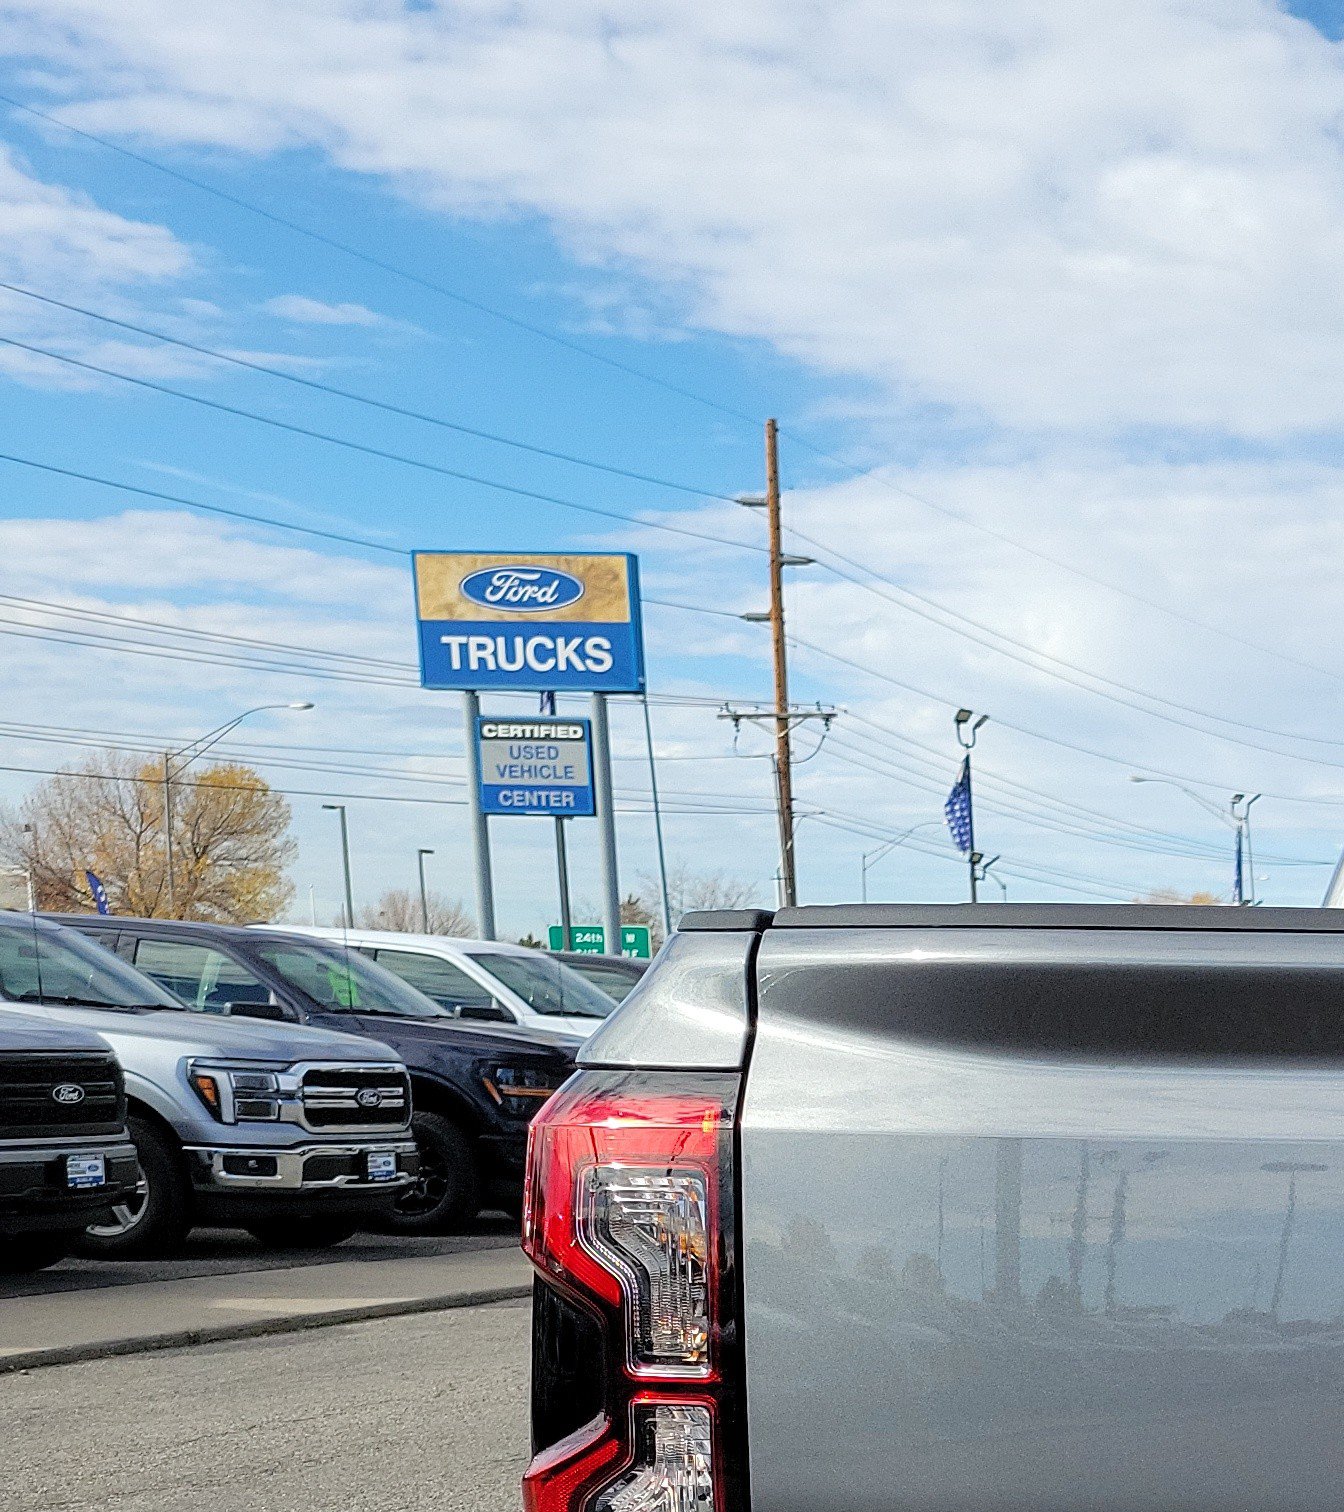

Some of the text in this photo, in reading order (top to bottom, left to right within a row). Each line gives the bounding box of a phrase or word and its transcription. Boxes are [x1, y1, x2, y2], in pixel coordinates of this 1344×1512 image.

[484, 570, 560, 603] Ford
[440, 635, 614, 673] TRUCKS
[482, 724, 584, 739] CERTIFIED
[509, 745, 559, 760] USED
[496, 764, 575, 780] VEHICLE
[499, 790, 575, 808] CENTER
[575, 932, 603, 944] 24th
